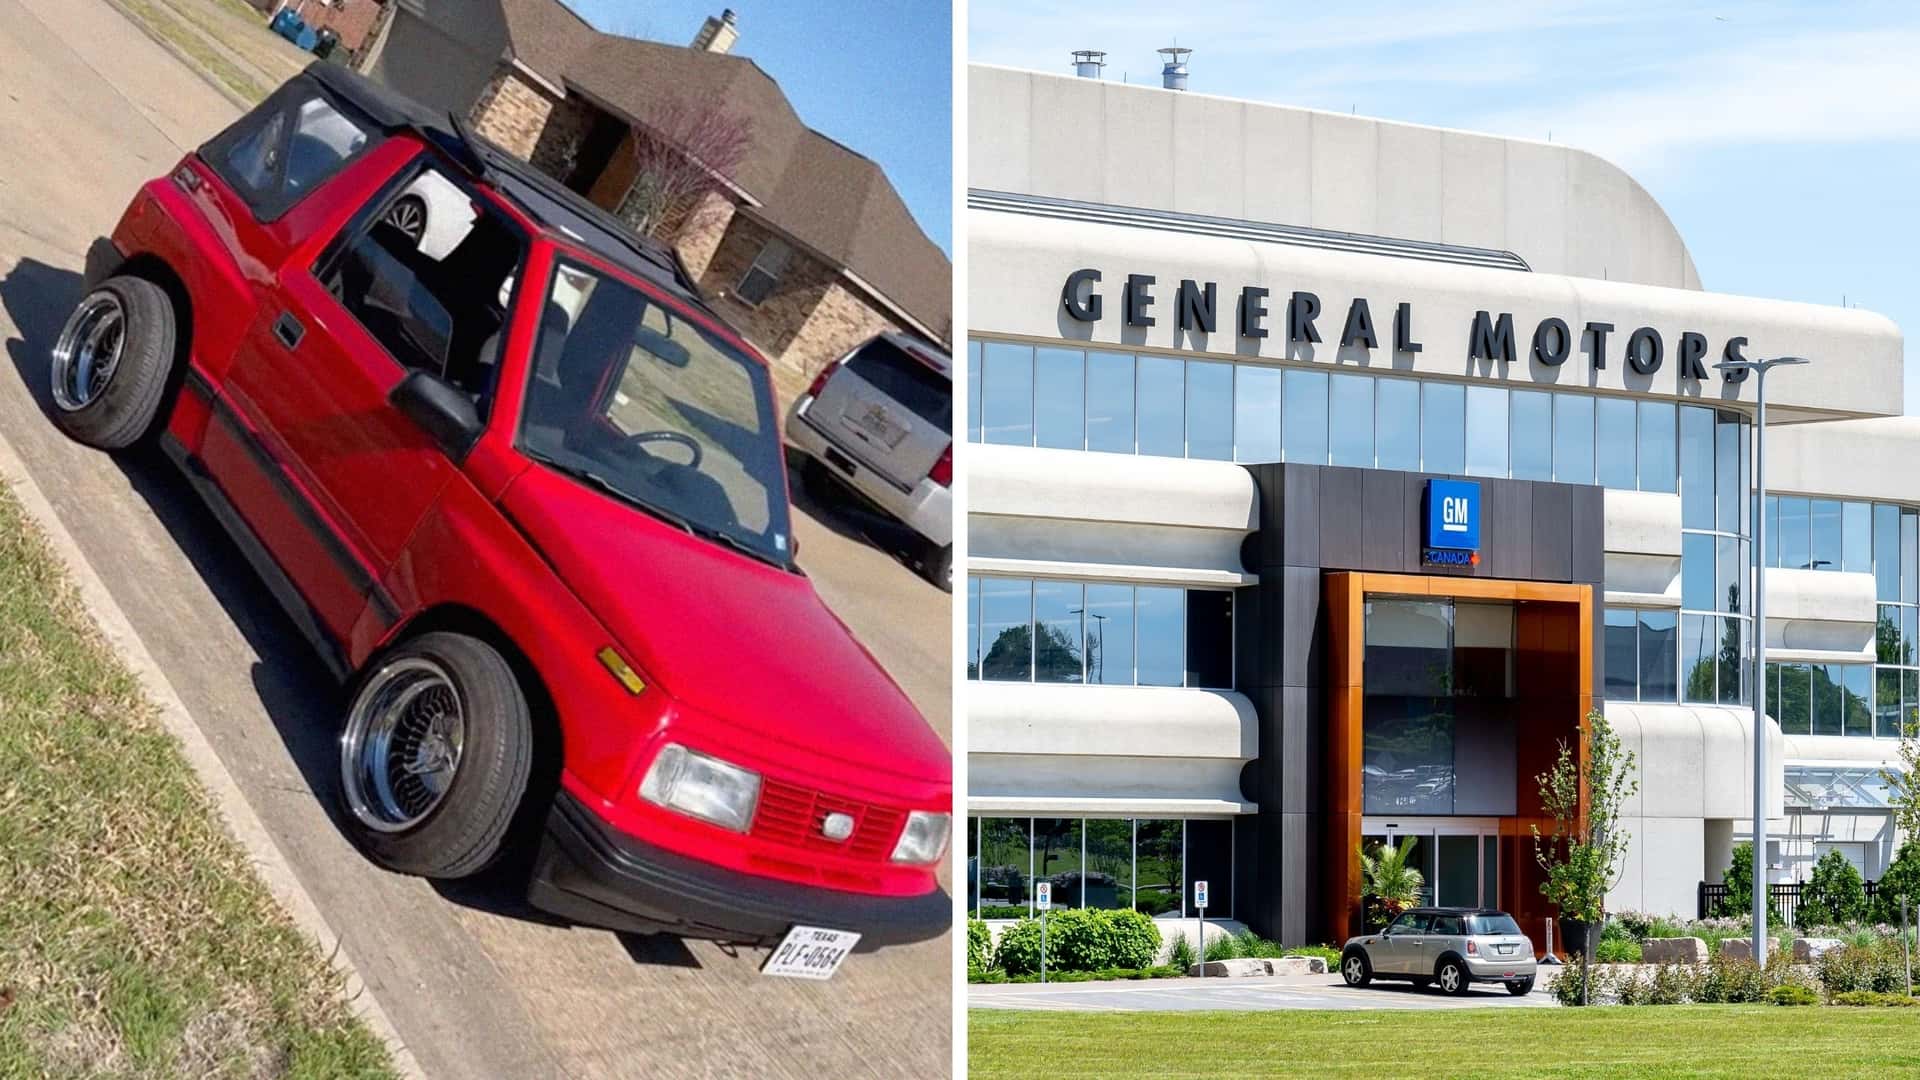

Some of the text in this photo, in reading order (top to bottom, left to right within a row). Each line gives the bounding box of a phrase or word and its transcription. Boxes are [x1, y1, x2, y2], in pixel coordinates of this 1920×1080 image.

[1063, 268, 1750, 384] GENERAL MOTORS
[1443, 496, 1469, 524] GM
[1429, 551, 1471, 565] CANADA
[810, 930, 839, 943] TEXAS
